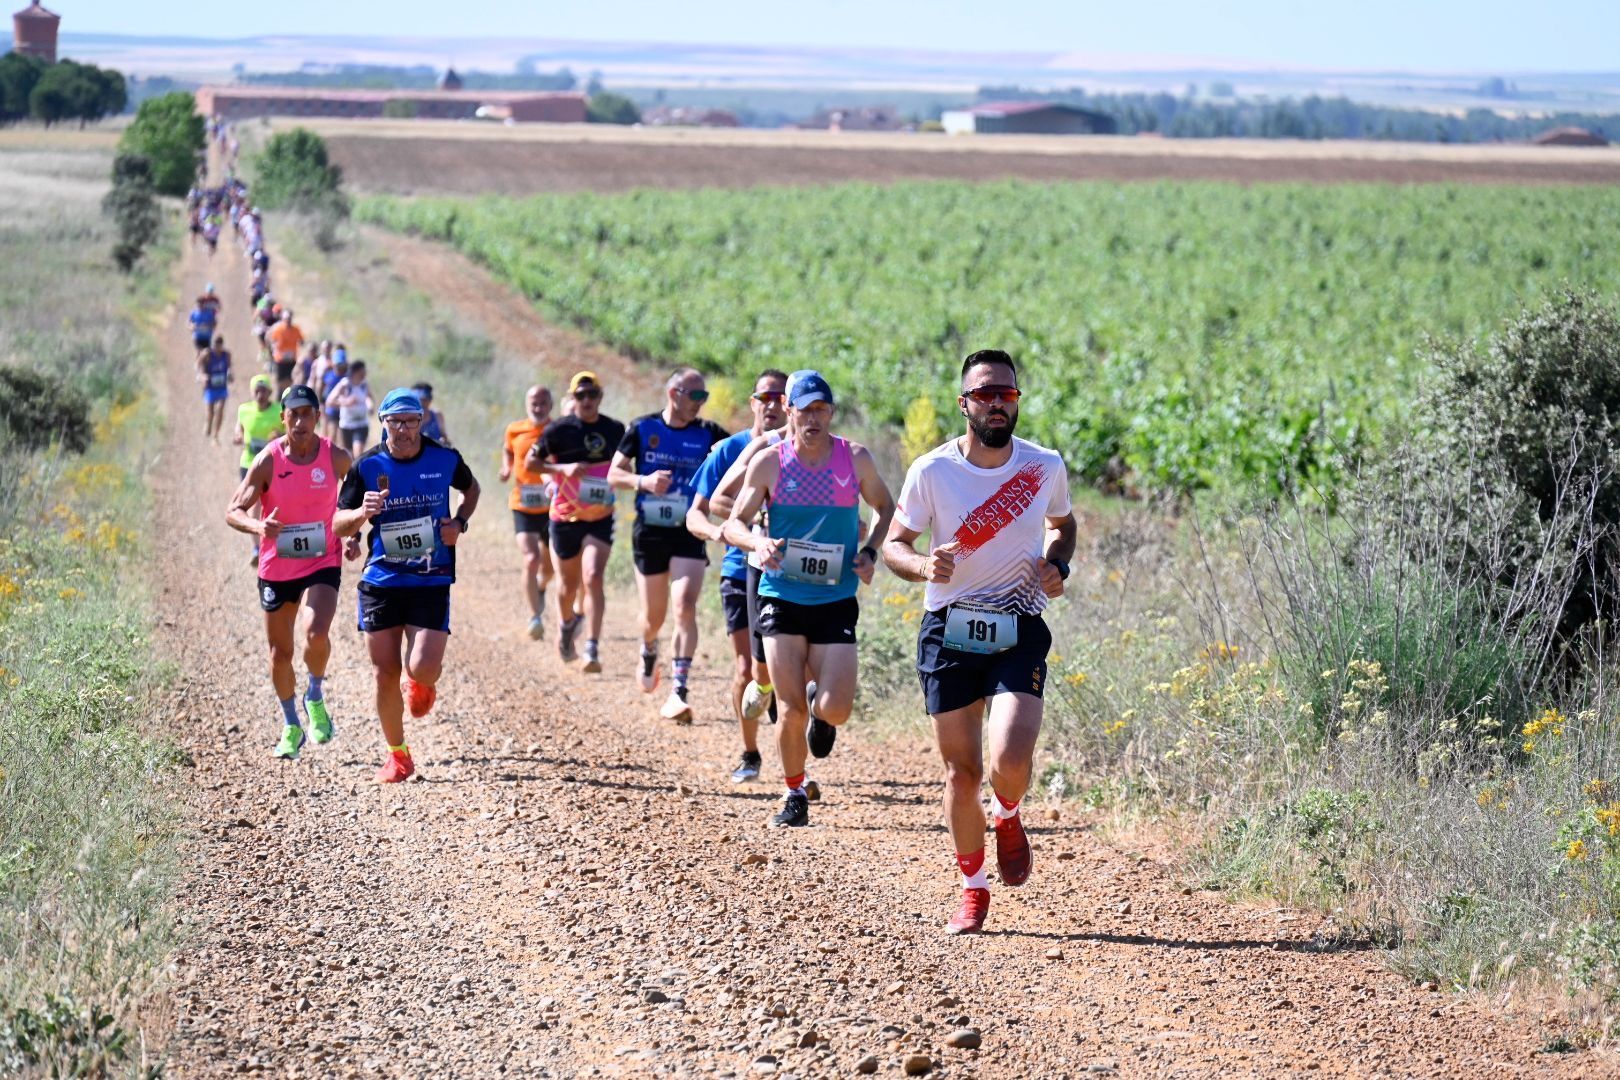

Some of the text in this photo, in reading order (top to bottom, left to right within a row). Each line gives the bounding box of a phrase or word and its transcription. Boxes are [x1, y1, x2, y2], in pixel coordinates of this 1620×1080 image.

[387, 493, 445, 506] AREACLINICA
[965, 478, 1030, 535] DESPENSA
[658, 506, 673, 520] 16
[989, 489, 1036, 531] DE FER
[293, 536, 310, 552] 81
[395, 532, 423, 551] 195
[800, 556, 829, 576] 189
[966, 619, 997, 643] 191
